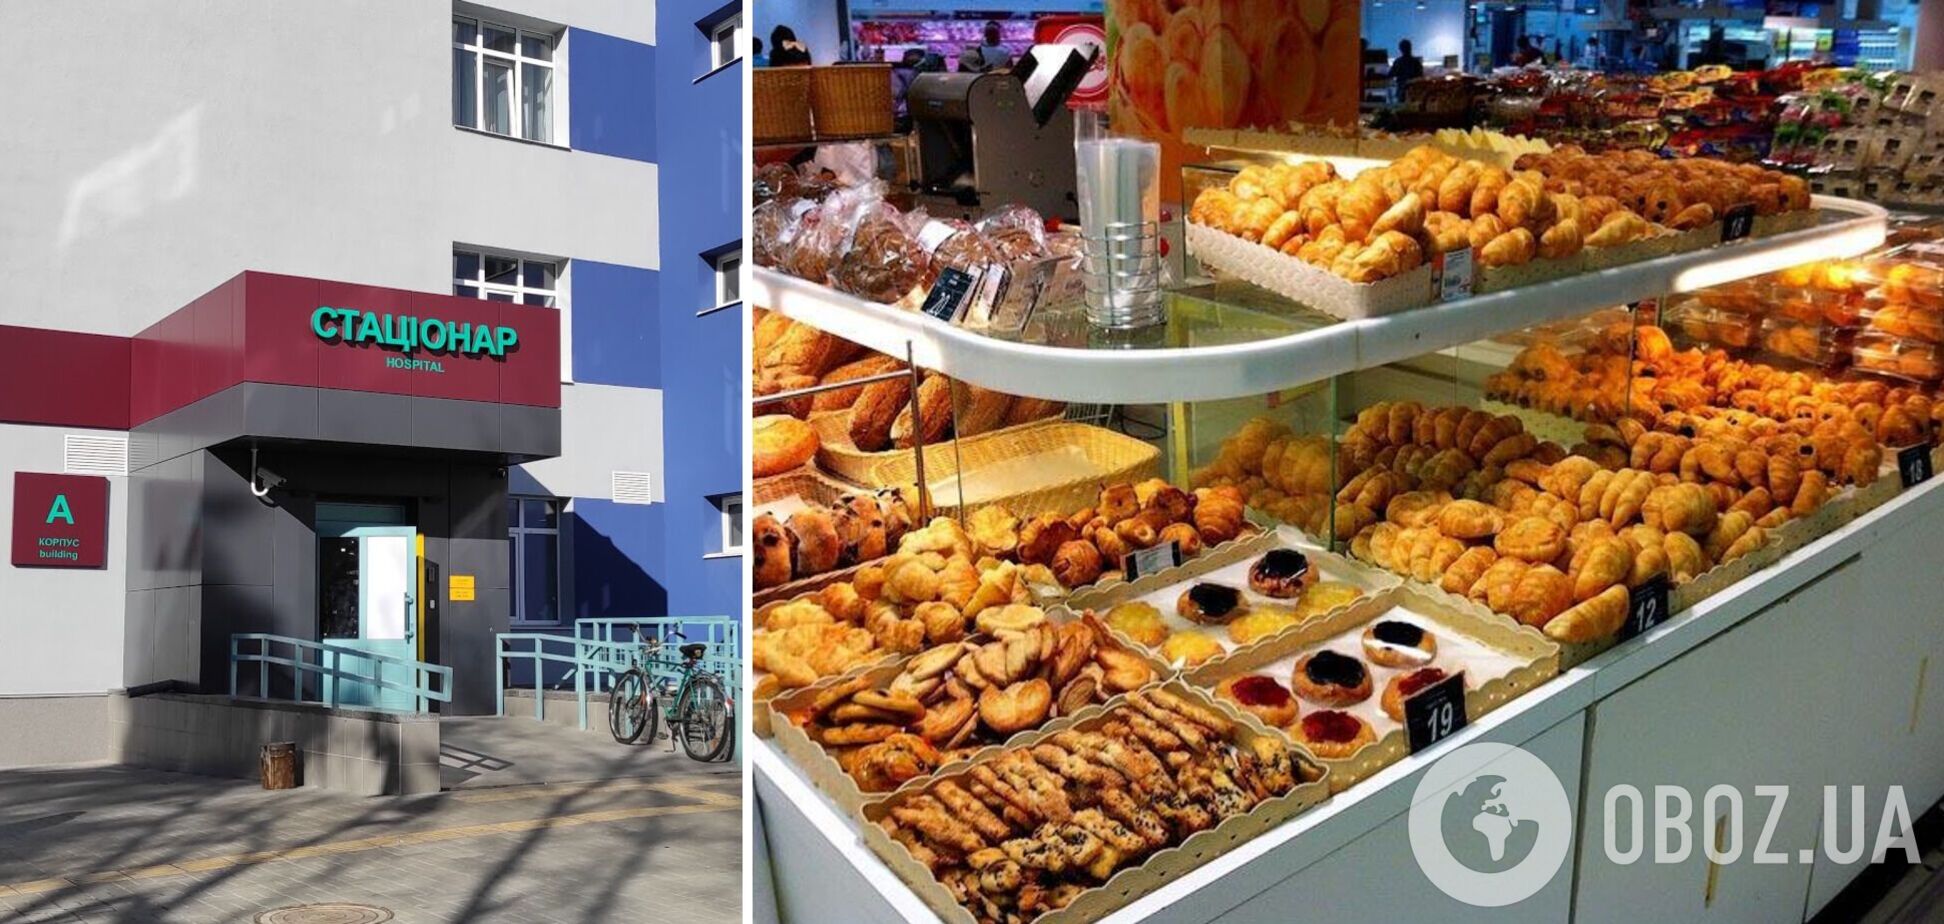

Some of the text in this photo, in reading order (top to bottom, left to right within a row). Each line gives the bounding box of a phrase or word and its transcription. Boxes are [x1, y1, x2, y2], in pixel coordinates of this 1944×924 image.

[310, 306, 518, 356] СТАЦІОНАР
[386, 356, 446, 373] HOSPITAL
[39, 537, 80, 547] КОРПУС
[39, 550, 78, 561] building
[1636, 597, 1657, 632] 12
[1427, 701, 1453, 743] 19
